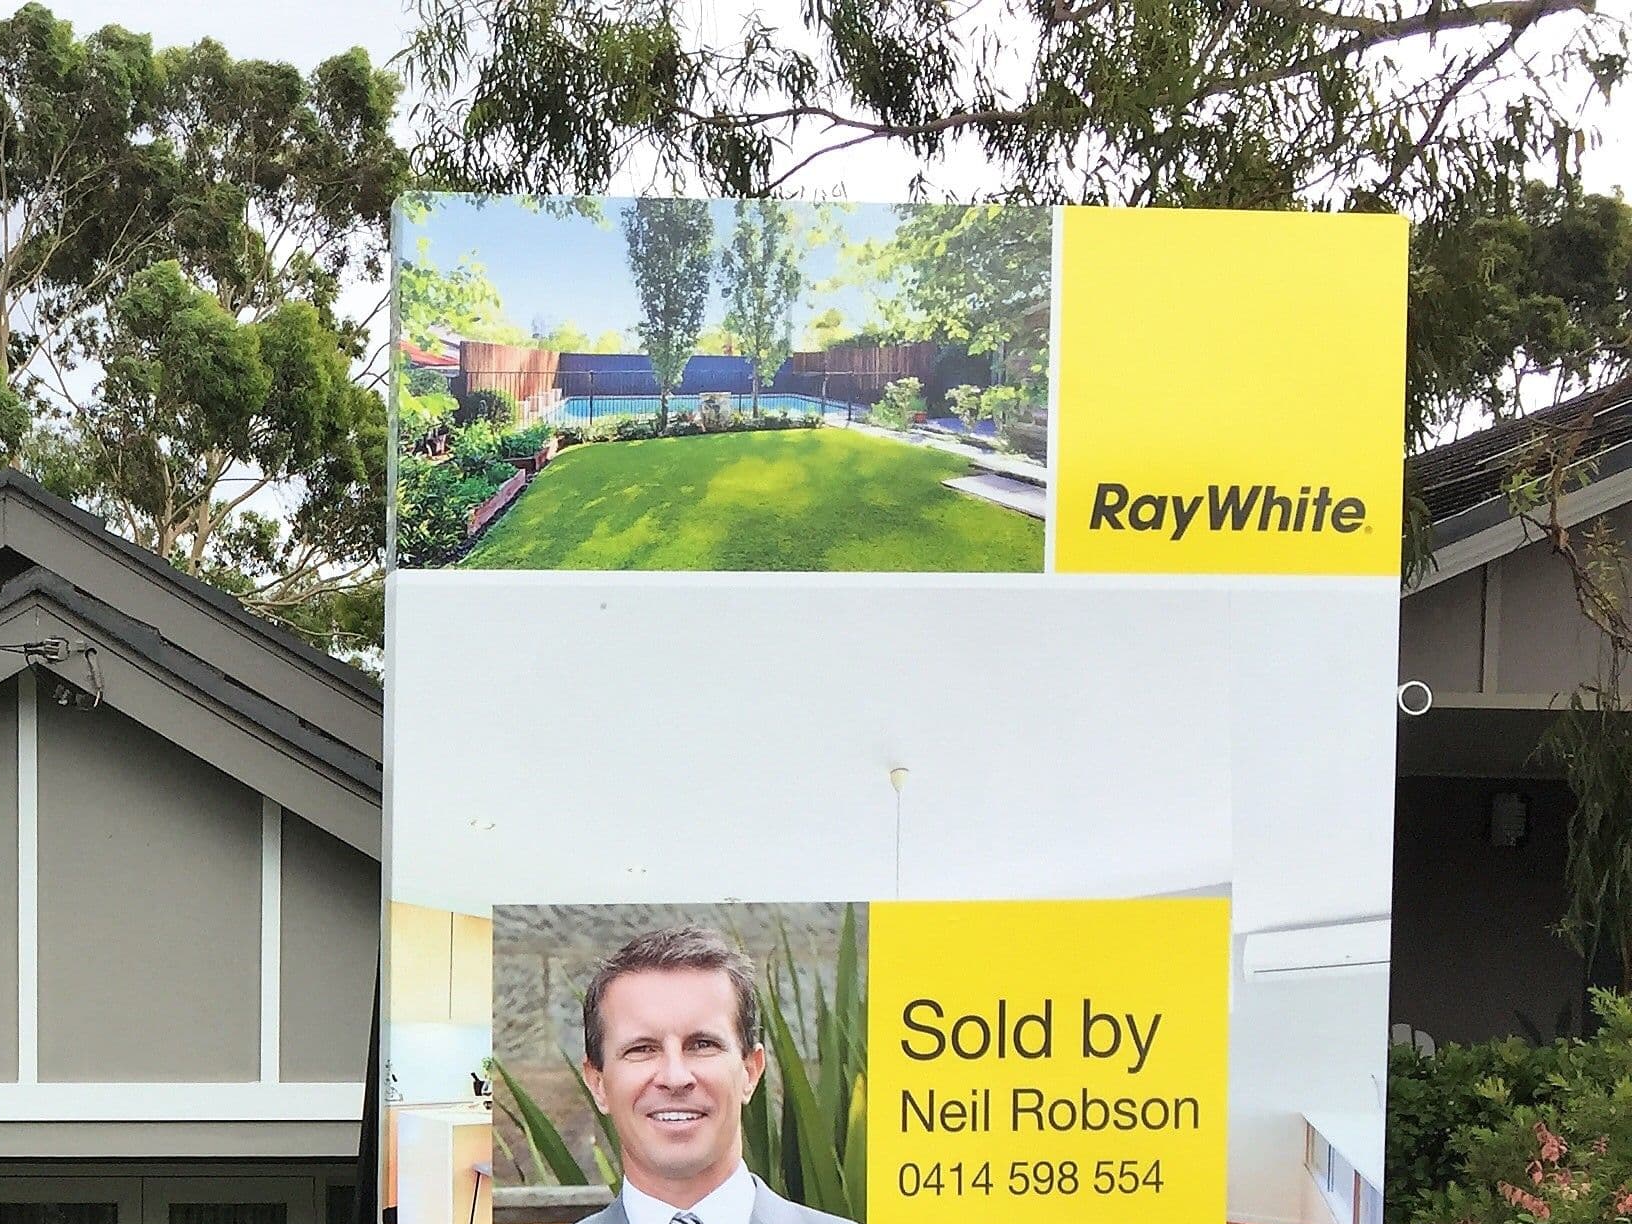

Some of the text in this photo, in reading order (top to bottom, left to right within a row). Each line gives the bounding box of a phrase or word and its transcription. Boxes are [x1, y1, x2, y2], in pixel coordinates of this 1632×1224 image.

[1090, 483, 1366, 540] RayWhite
[901, 999, 1161, 1073] Sold by
[902, 1088, 1198, 1132] Neil Robson
[899, 1160, 1164, 1196] 0414 598 554
